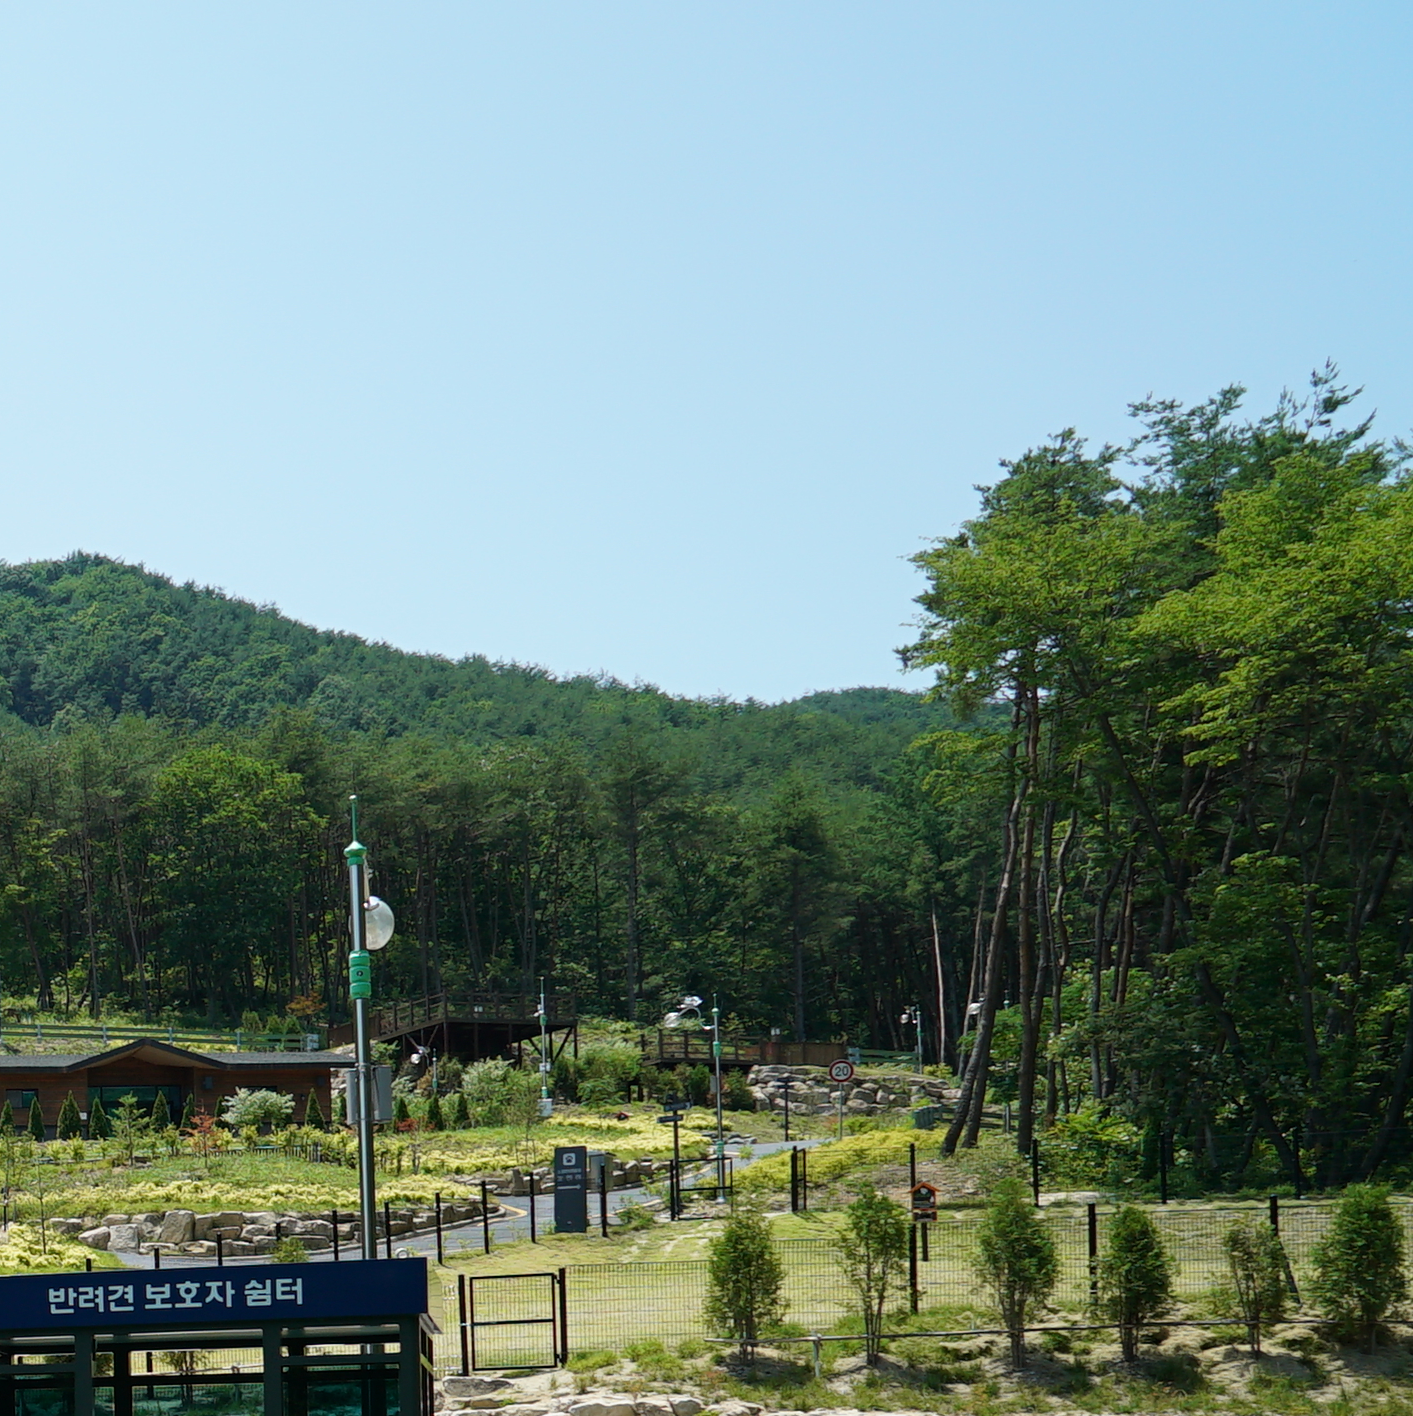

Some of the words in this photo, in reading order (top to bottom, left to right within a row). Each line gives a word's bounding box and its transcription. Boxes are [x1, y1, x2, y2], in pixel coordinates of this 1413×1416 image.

[834, 1065, 849, 1077] 20
[48, 1285, 135, 1315] 반려견
[144, 1280, 236, 1310] 보호자
[244, 1278, 304, 1307] 쉼터
